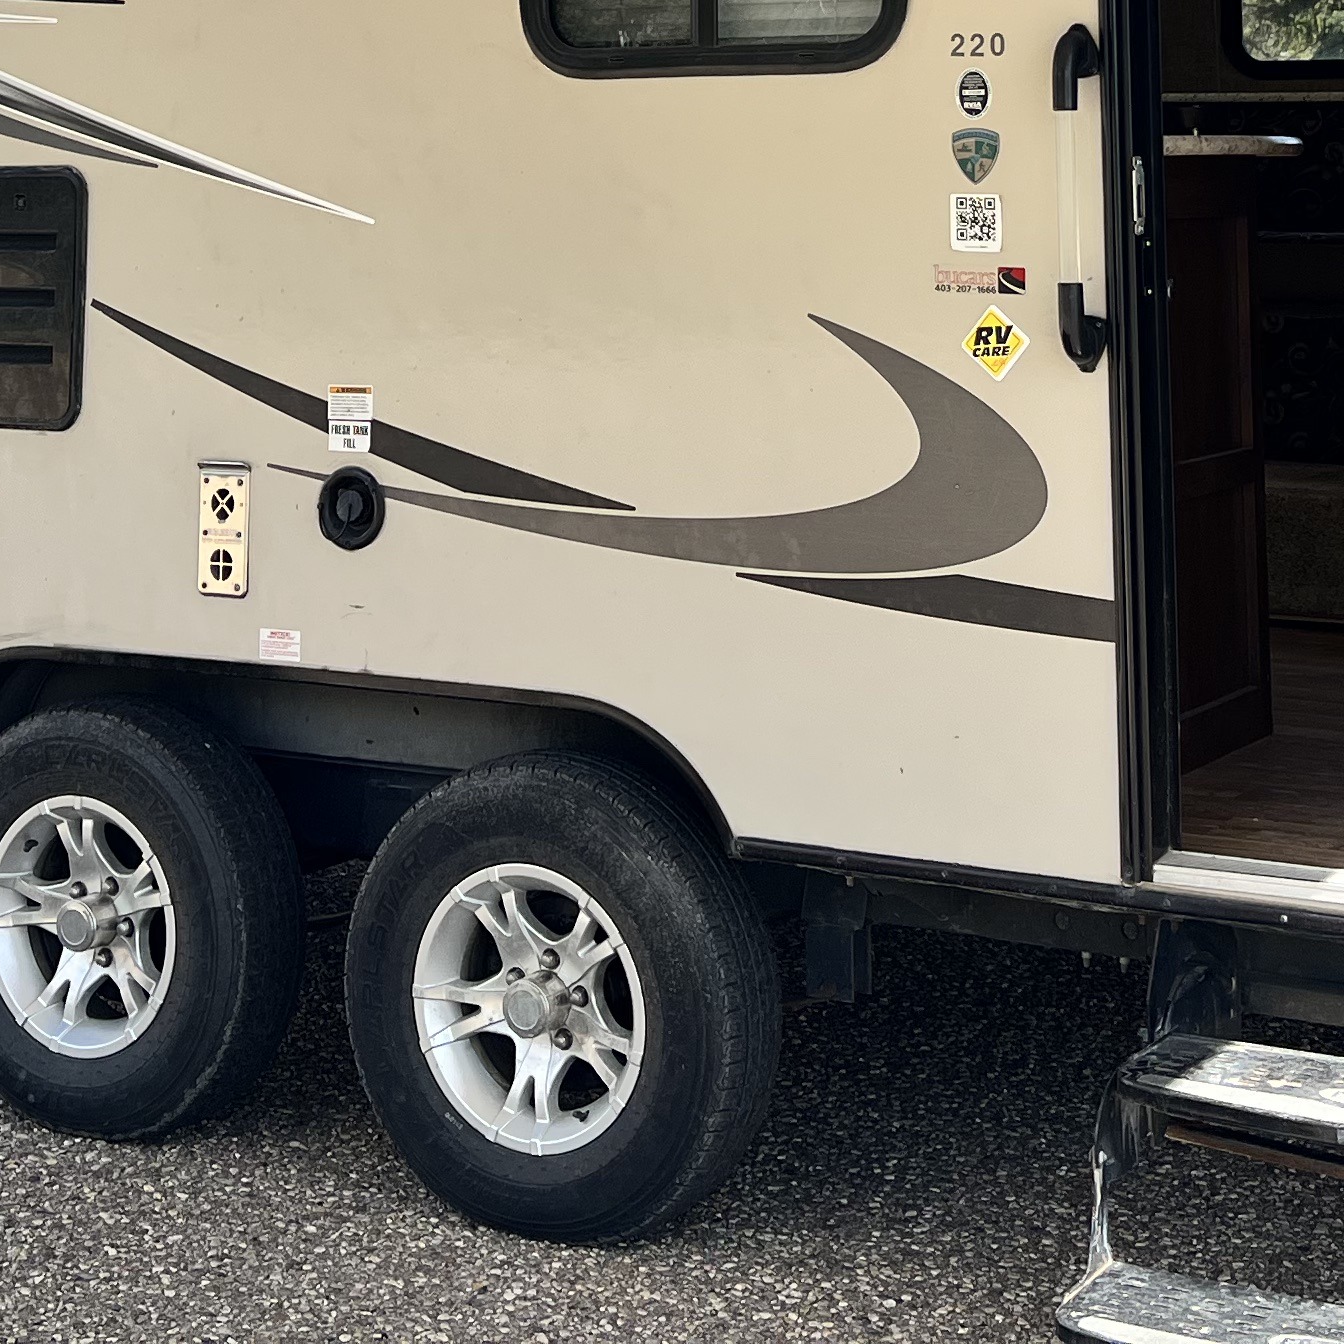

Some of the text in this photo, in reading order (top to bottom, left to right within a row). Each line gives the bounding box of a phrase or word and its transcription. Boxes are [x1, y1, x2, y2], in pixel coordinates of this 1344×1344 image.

[950, 32, 1006, 58] 220
[933, 264, 997, 286] bucars
[973, 324, 1014, 346] RV
[972, 346, 1011, 357] CARE
[331, 424, 369, 436] FRESH TANK
[343, 438, 356, 449] FILL
